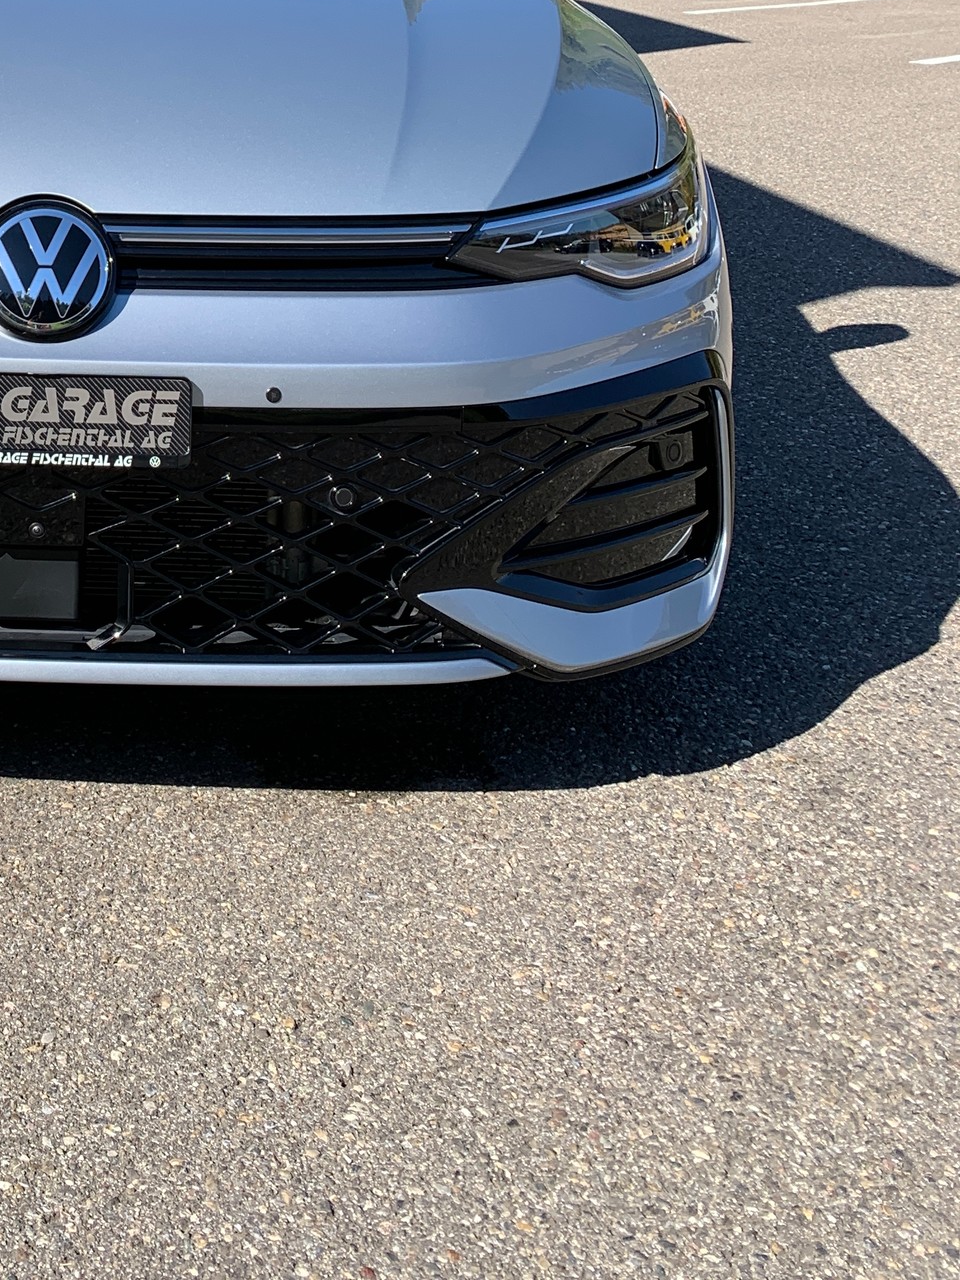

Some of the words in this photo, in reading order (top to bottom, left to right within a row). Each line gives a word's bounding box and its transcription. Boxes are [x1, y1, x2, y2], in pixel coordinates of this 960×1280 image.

[0, 386, 180, 426] GARAGE
[2, 426, 134, 448] FISCHENTHAL
[140, 430, 173, 449] AG
[31, 452, 110, 466] FISCHENTHAL
[114, 455, 133, 467] AG
